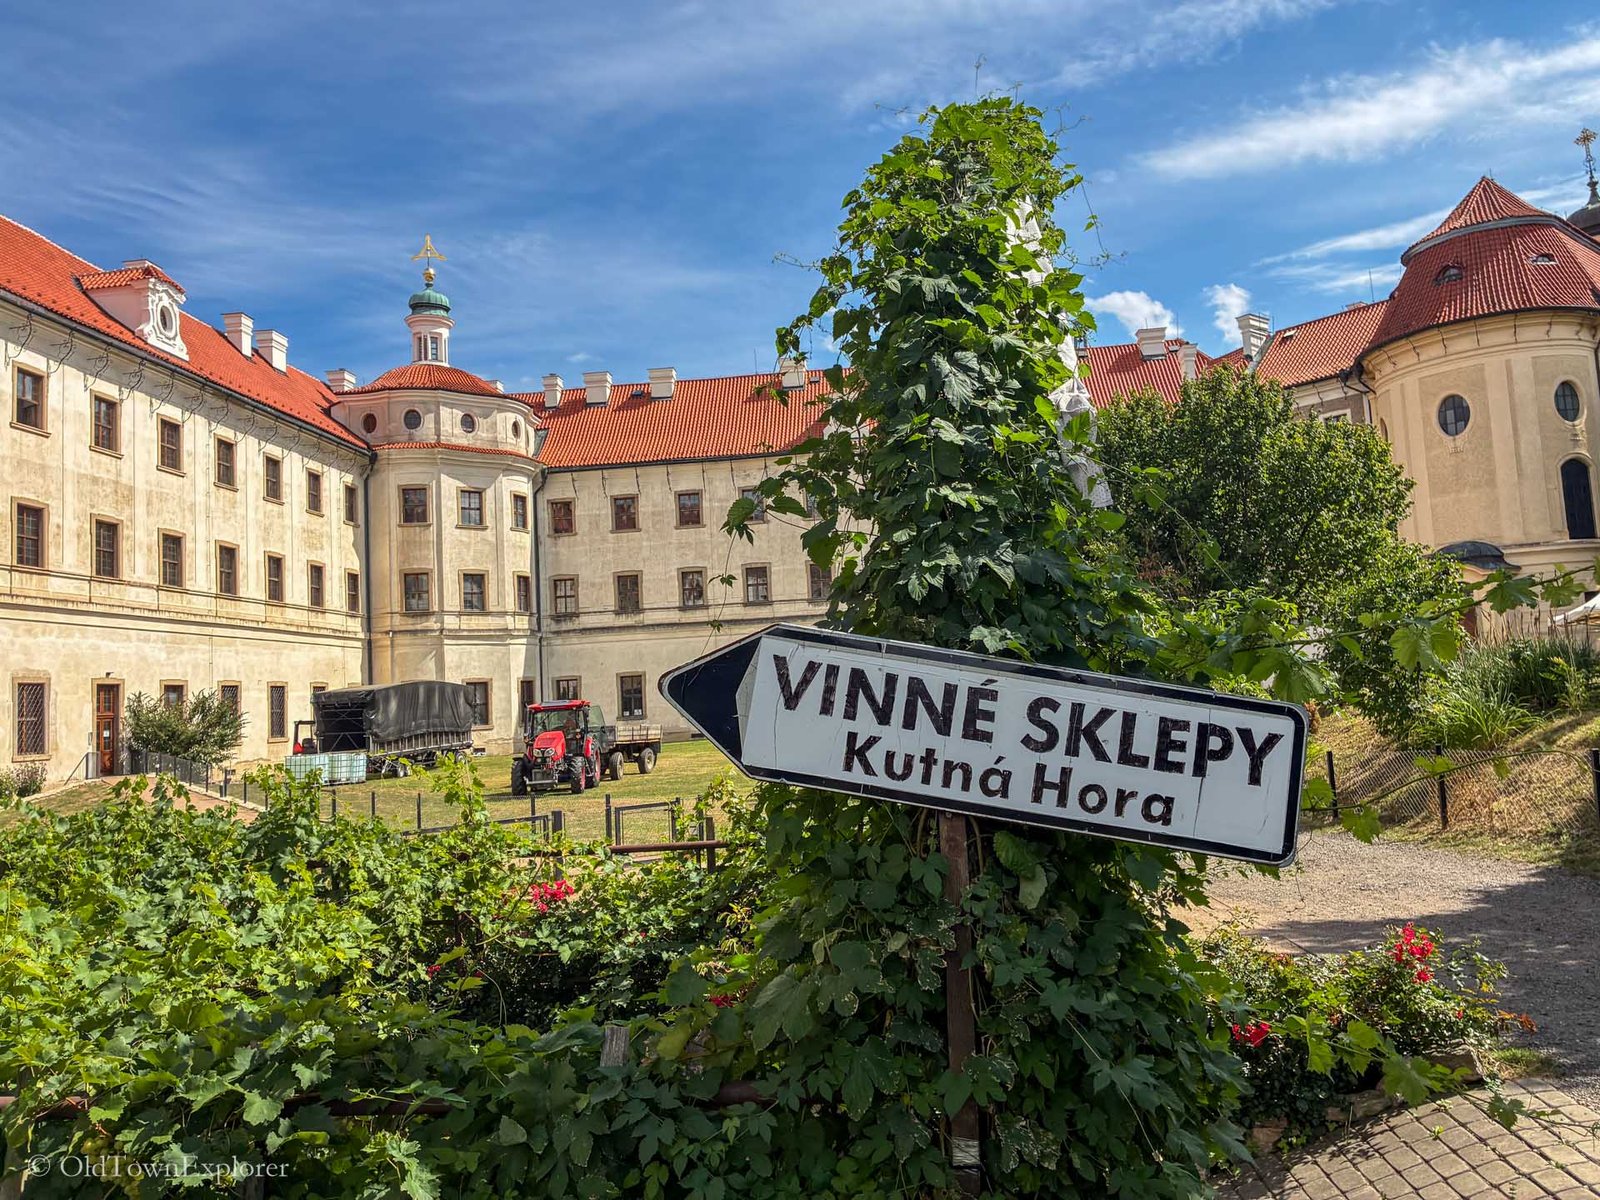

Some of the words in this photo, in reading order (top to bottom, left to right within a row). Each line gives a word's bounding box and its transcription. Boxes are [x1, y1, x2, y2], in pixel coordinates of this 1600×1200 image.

[773, 654, 999, 743] VINNÉ
[1020, 697, 1284, 787] SKLEPY
[842, 731, 1011, 799] Kutná
[1030, 762, 1176, 826] Hora
